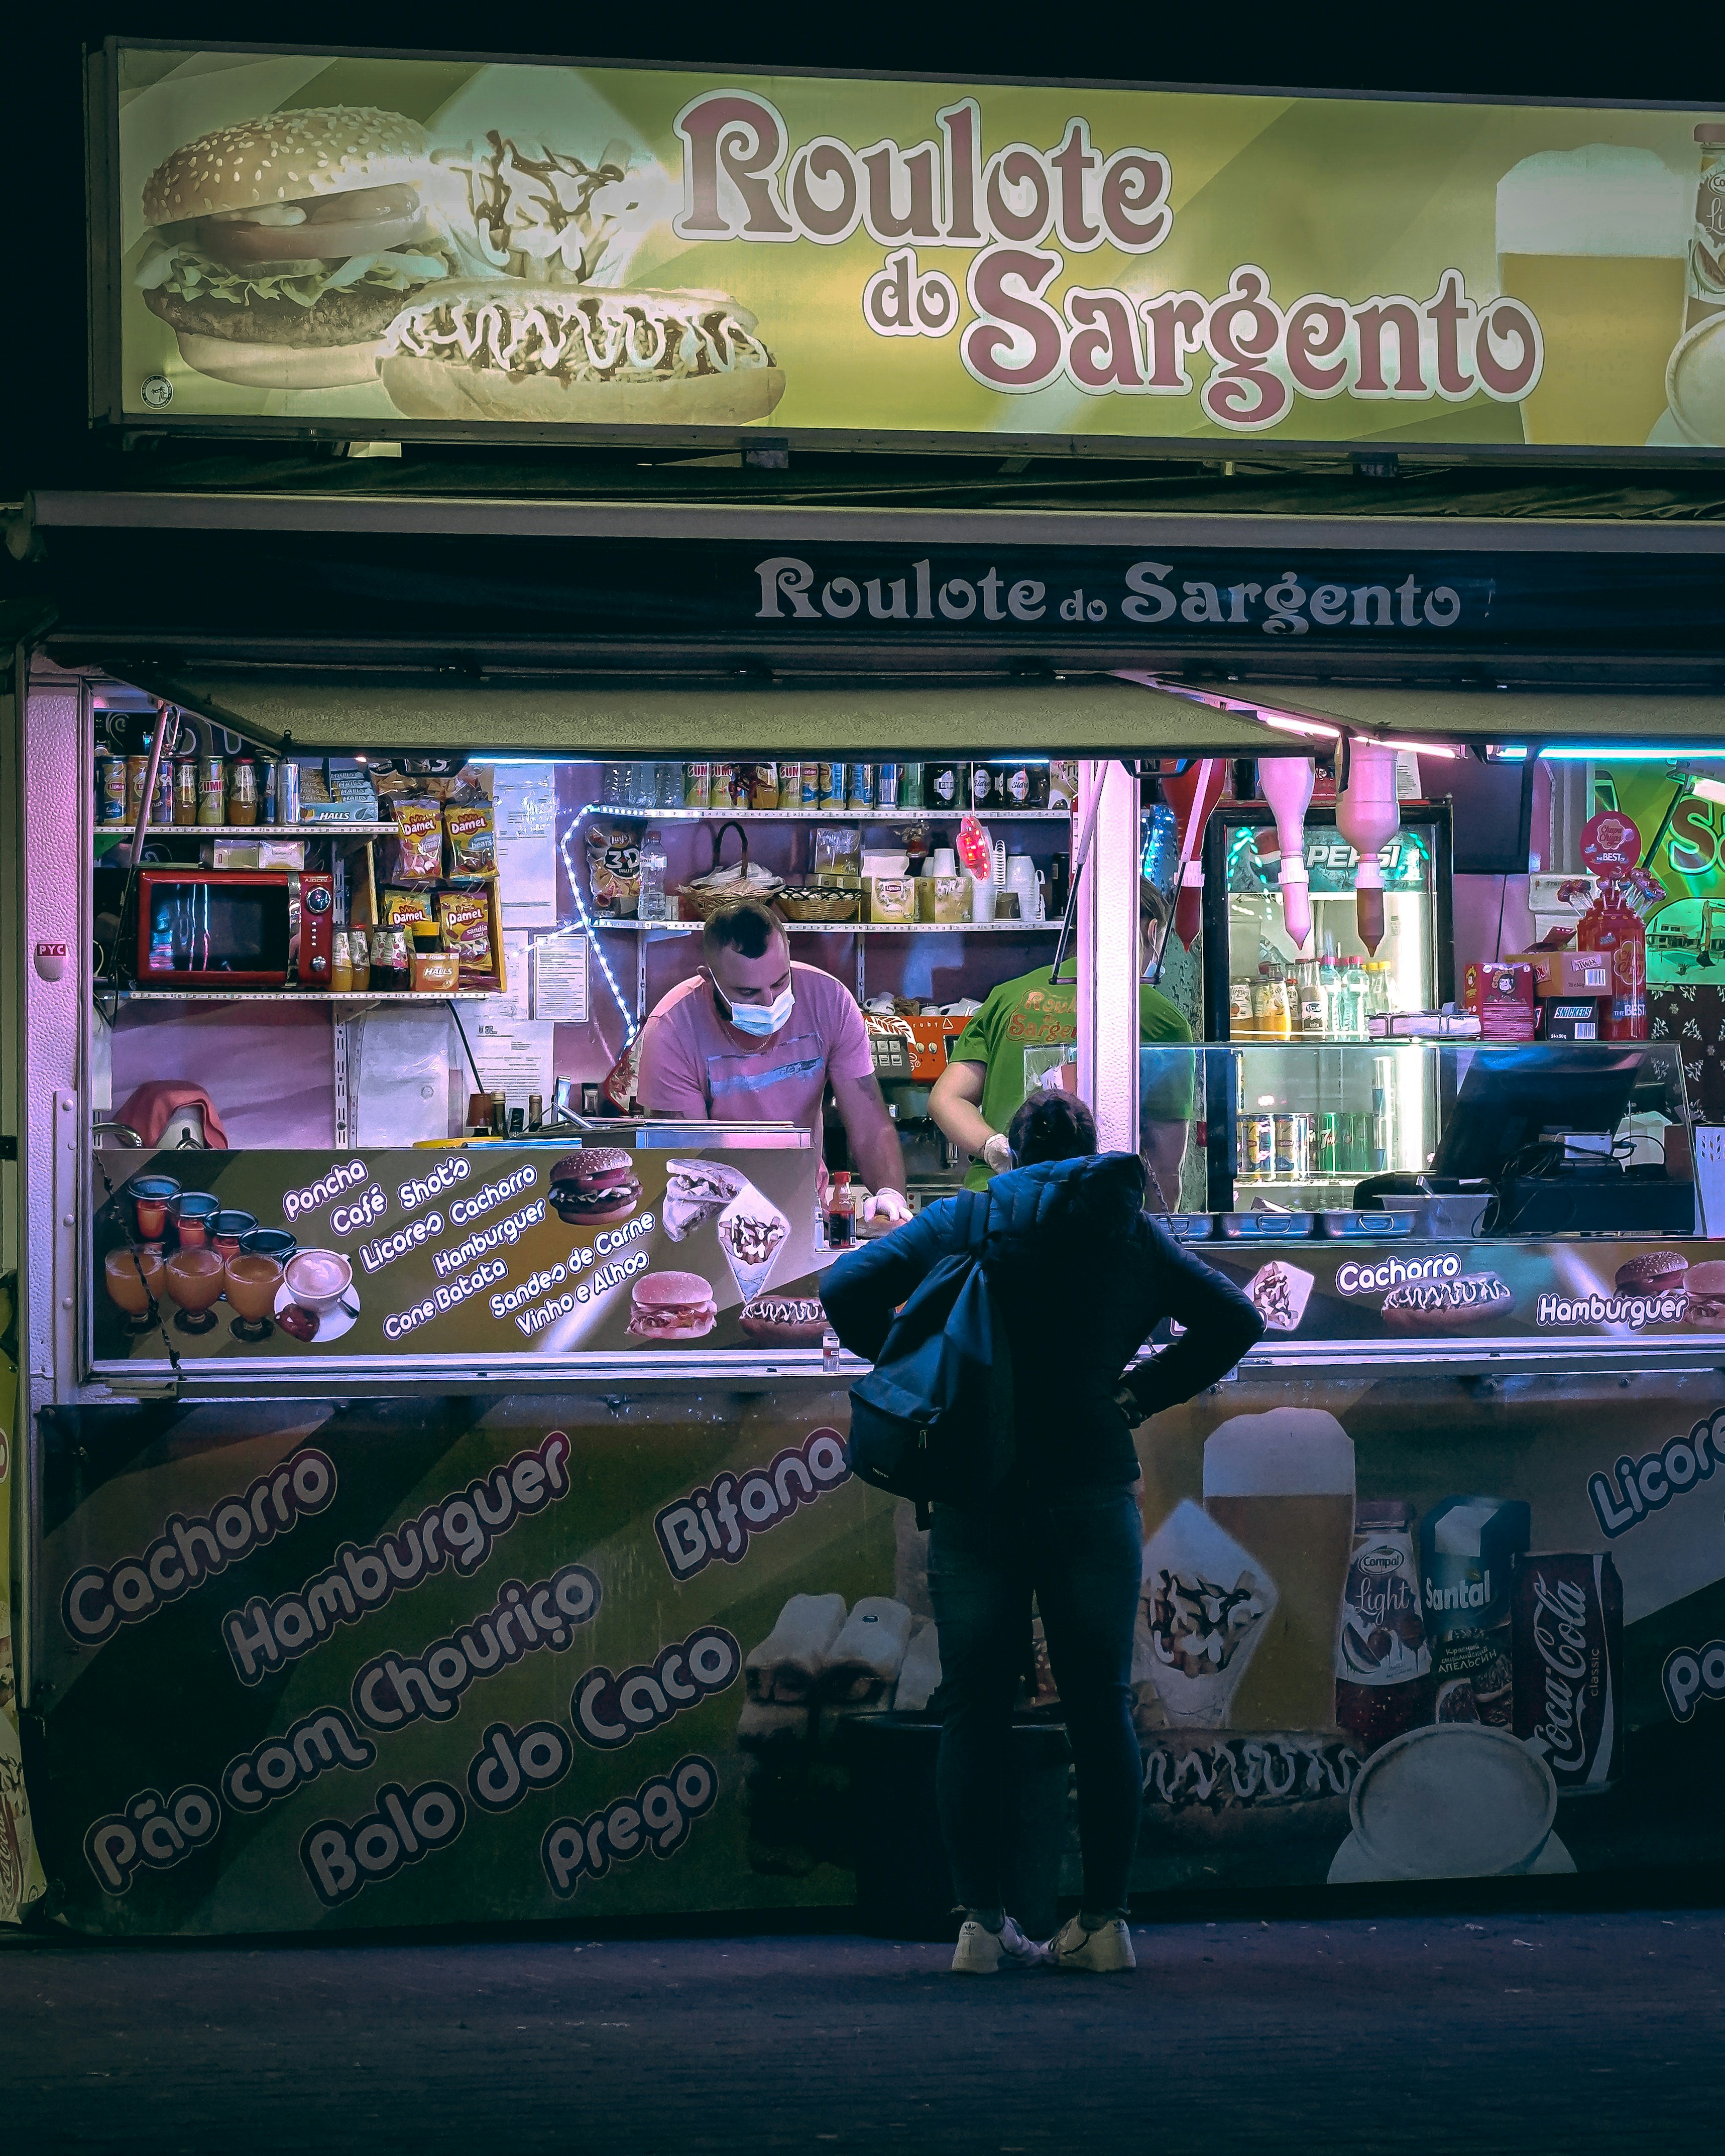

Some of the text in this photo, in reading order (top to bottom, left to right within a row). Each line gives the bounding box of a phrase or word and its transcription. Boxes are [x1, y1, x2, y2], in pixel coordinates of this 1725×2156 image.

[680, 97, 1165, 245] Roulote
[870, 248, 1537, 423] do Sargento
[754, 557, 1460, 635] Roulote do Sargento
[319, 811, 350, 821] HALLS
[404, 819, 435, 836] Damel
[451, 818, 486, 835] Damel
[471, 840, 492, 849] bears
[606, 848, 640, 869] 3D
[611, 834, 628, 845] Lay's
[1603, 853, 1622, 862] BEST
[393, 910, 425, 924] Damel
[449, 908, 483, 925] Damel
[467, 925, 488, 935] sandía
[39, 945, 64, 955] PYC
[424, 968, 452, 977] HALLS
[1025, 992, 1077, 1014] Roul
[1556, 1007, 1591, 1018] SNICKERS
[1624, 1004, 1645, 1016] BEST
[1009, 1014, 1077, 1042] Sarge
[286, 1161, 366, 1219] Poncha
[400, 1159, 469, 1209] Shot's
[332, 1185, 385, 1234] Café
[360, 1166, 535, 1271] Licores Cachorro
[434, 1200, 544, 1276] Hamburguer
[490, 1214, 653, 1315] Sandes de Carne
[1337, 1255, 1459, 1293] Cachorro
[385, 1260, 506, 1338] Cone Batata
[517, 1252, 647, 1334] Vinho e Alhos
[1540, 1295, 1687, 1327] Hamburguer
[1594, 1414, 1725, 1530] Licore
[661, 1436, 846, 1571] Bifana
[69, 1458, 329, 1635] Cachorro
[230, 1440, 562, 1675] Hamburguer
[1363, 1555, 1399, 1569] Compal
[1354, 1577, 1410, 1625] Light
[1426, 1570, 1490, 1611] Santal
[1438, 1648, 1497, 1673] АПЕЛЬСИН
[1590, 1647, 1600, 1697] classic
[94, 1794, 211, 1886] Pão
[230, 1715, 368, 1804] com
[360, 1573, 594, 1725] Chouriço
[310, 1636, 732, 1897] Bolo do Caco
[549, 1763, 709, 1888] Prego
